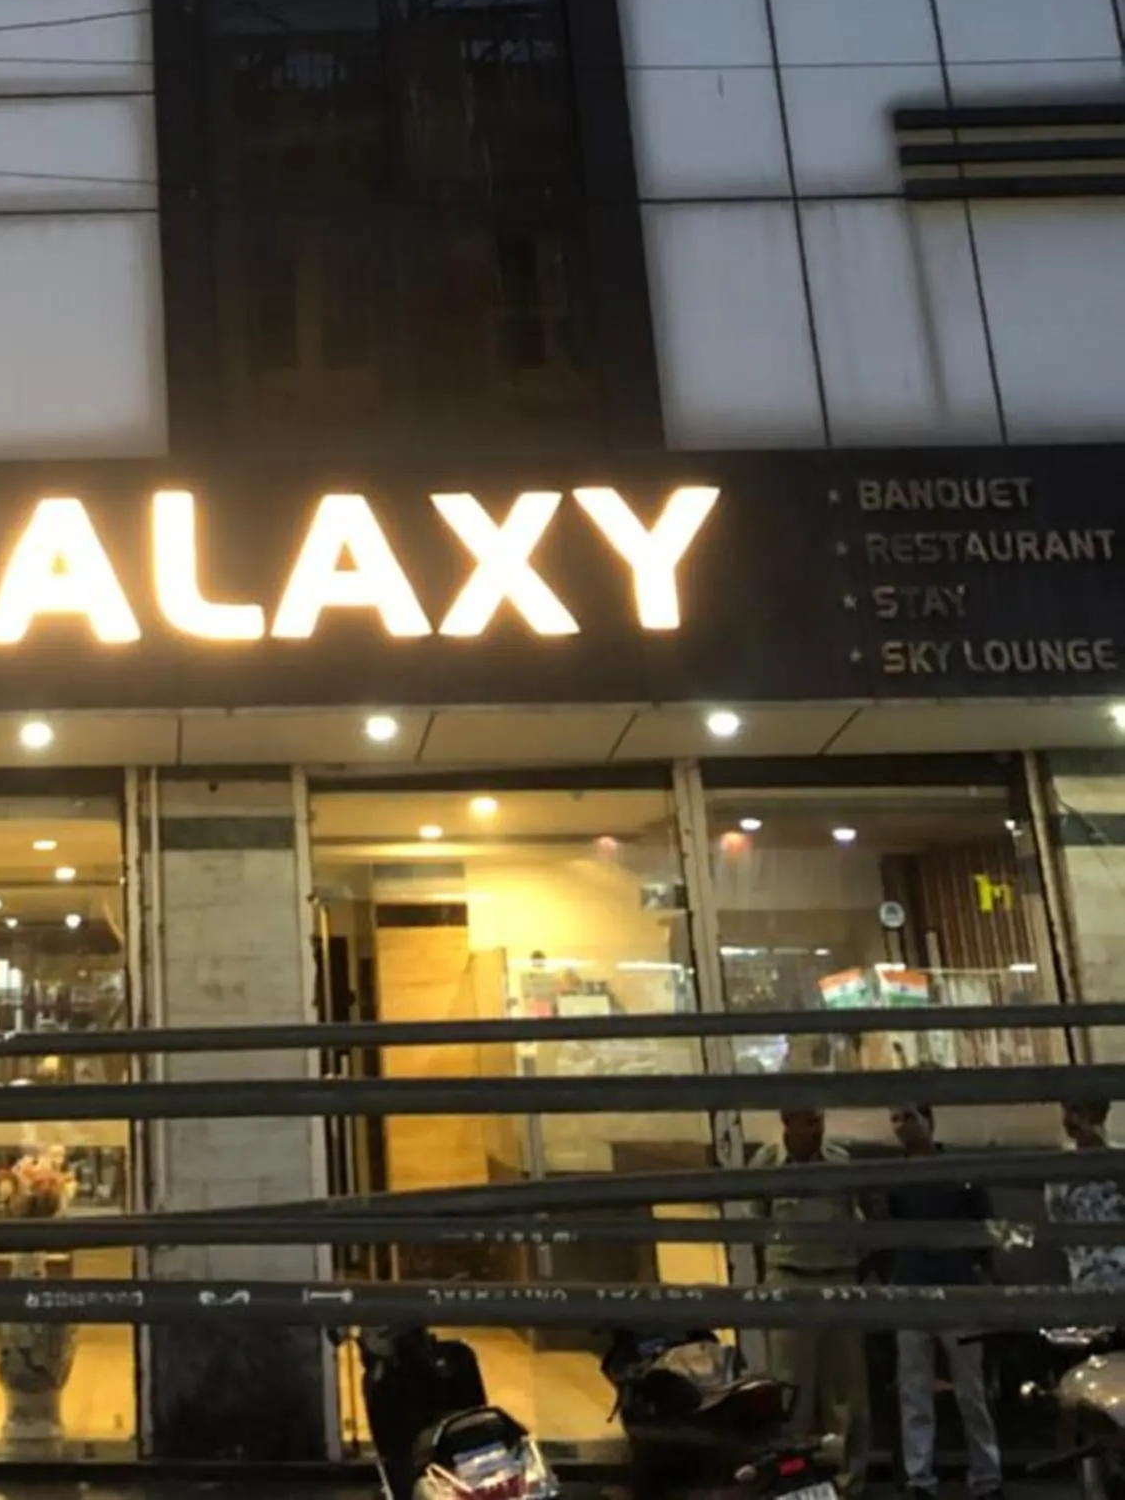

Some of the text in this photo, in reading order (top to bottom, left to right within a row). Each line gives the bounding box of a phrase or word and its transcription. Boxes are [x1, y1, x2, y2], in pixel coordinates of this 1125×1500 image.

[857, 477, 1032, 512] BANQUET
[865, 529, 1115, 564] RESTAURANT
[873, 584, 967, 619] STAY
[882, 638, 1118, 674] SKY LOUNGE
